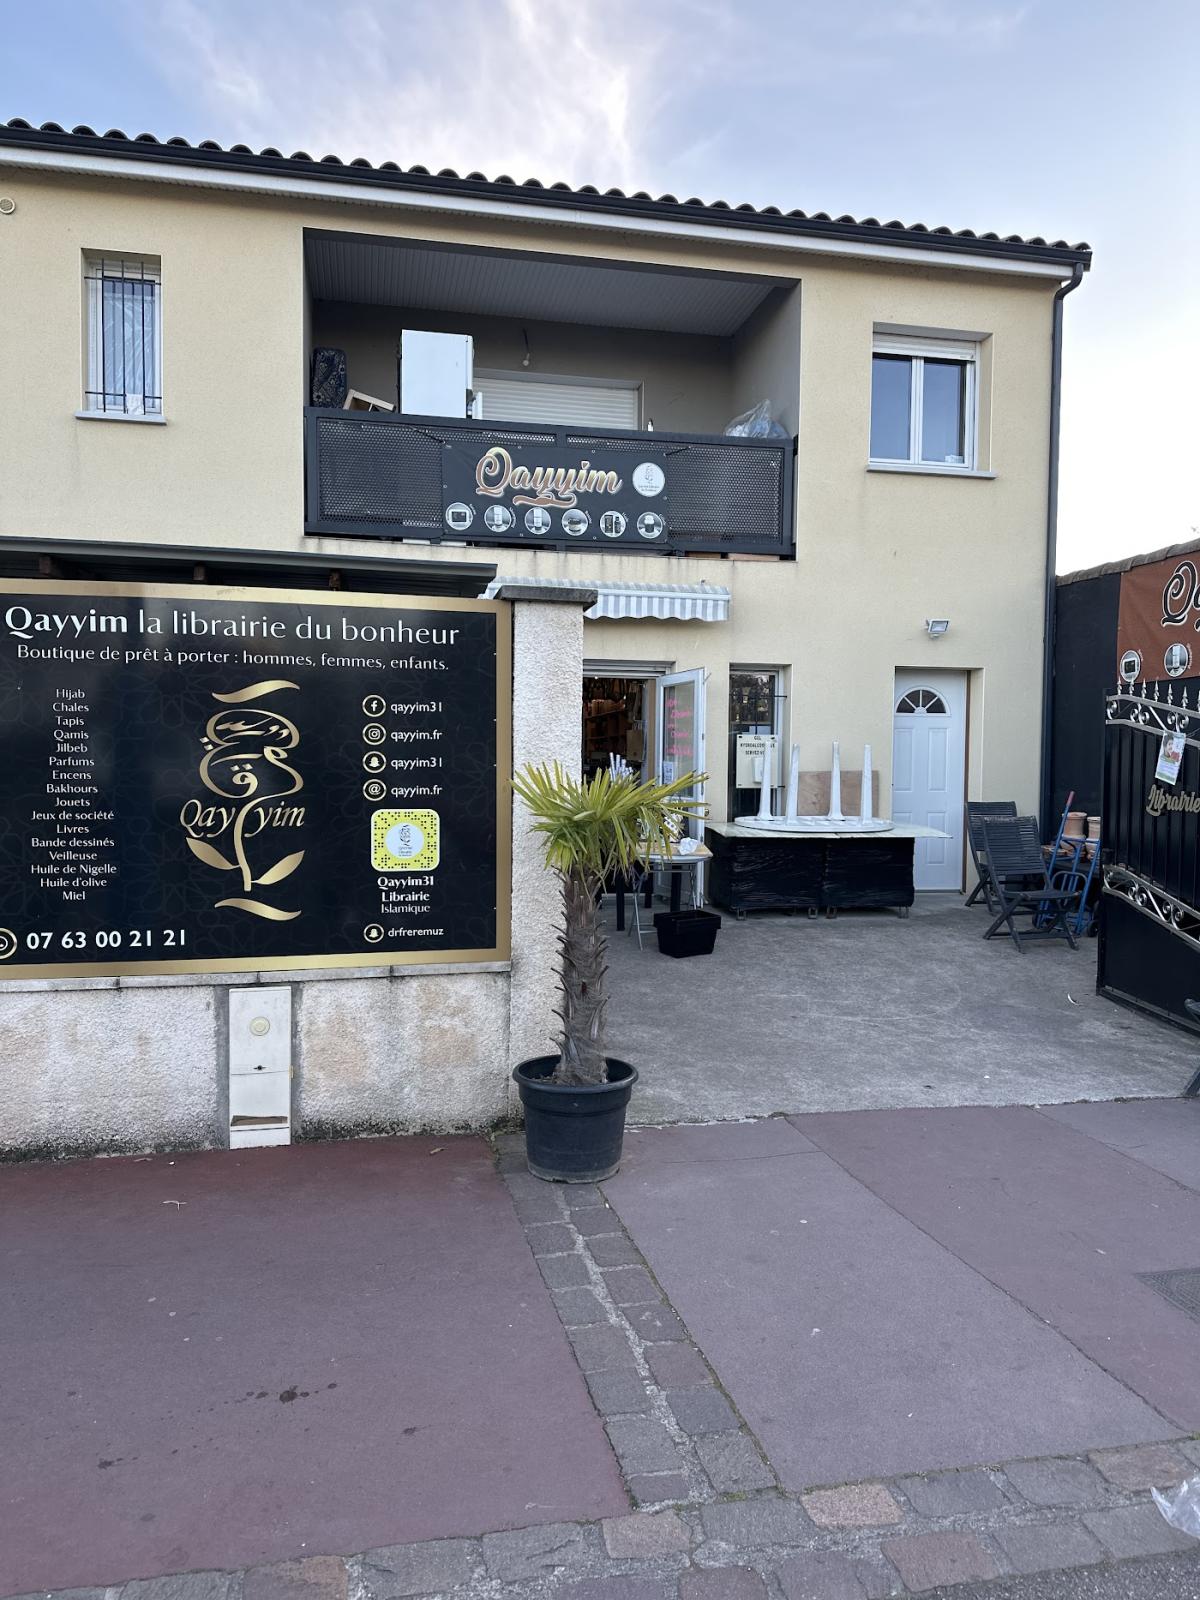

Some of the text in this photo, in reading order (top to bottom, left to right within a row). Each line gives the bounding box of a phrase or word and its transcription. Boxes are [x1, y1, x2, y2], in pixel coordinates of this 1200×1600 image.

[475, 446, 623, 508] Qayyim
[5, 606, 460, 645] Qayyim la librairie du bonheur
[17, 644, 95, 663] Boutique
[99, 646, 120, 661] de
[125, 648, 159, 664] prêt
[163, 648, 173, 662] à
[177, 650, 230, 665] porter
[243, 650, 316, 667] hommes,
[321, 653, 386, 670] femmes,
[390, 655, 449, 671] enfants.
[56, 689, 86, 701] Hijab
[52, 702, 90, 712] Chales
[390, 701, 442, 714] qayyim31
[55, 715, 85, 728] Tapis
[53, 729, 90, 742] Qamis
[390, 729, 443, 742] qayyim.fr
[55, 743, 88, 753] Jilbeb
[49, 756, 95, 766] Parfums
[390, 757, 442, 770] qayyim31
[52, 770, 92, 780] Encens
[46, 783, 99, 793] Bakhours
[390, 785, 443, 798] qayyim.fr
[55, 797, 91, 807] Jouets
[1146, 784, 1200, 816] Librairie
[31, 810, 115, 820] Jeux de société
[56, 824, 90, 834] Livres
[31, 837, 115, 848] Bande dessinés
[49, 851, 98, 861] Veilleuse
[31, 863, 117, 876] Huile de Nigelle
[40, 878, 70, 888] Huile
[377, 876, 434, 890] Qayyim31
[62, 891, 86, 901] Miel
[381, 891, 430, 902] Librairie
[381, 903, 431, 915] Islamique
[387, 928, 444, 937] drfreremuz
[26, 929, 185, 950] 07 63 00 21 21
